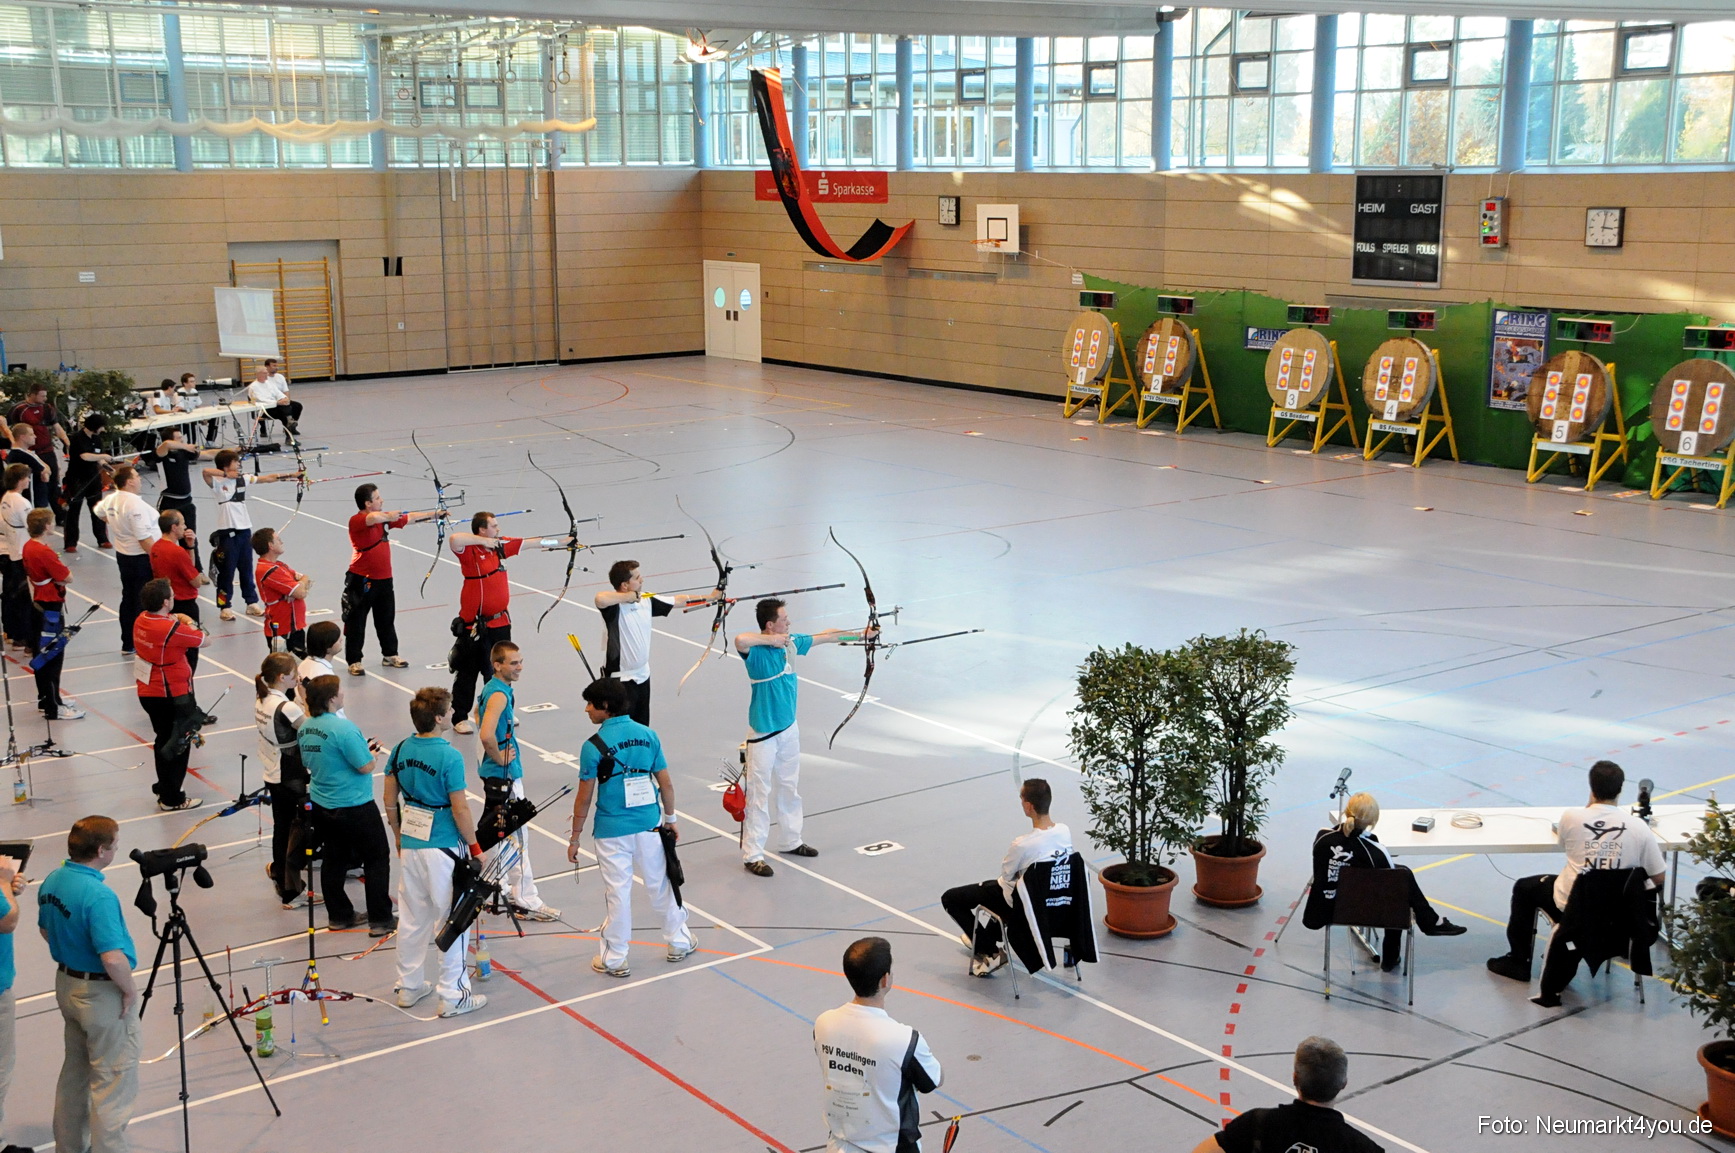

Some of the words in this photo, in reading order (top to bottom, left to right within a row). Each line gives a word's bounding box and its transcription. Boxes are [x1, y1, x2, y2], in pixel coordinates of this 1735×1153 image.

[833, 183, 875, 198] Sparkasse
[1358, 203, 1385, 213] HEIM
[1410, 203, 1438, 214] GAST
[1356, 242, 1376, 253] FOULS
[1382, 243, 1409, 254] SPIELER
[1416, 244, 1436, 255] FOULS
[1509, 311, 1547, 328] RING
[1153, 378, 1160, 391] 2
[1288, 393, 1296, 406] 3
[1386, 404, 1394, 417] 4
[1555, 425, 1564, 439] 5
[1682, 436, 1692, 451] 6
[1662, 456, 1677, 464] FSG
[1680, 458, 1720, 469] Tacherting
[617, 738, 651, 750] Welzheim
[863, 842, 894, 852] 8
[1584, 841, 1623, 850] BOGEN
[1051, 864, 1071, 872] BOGEN
[1584, 857, 1621, 870] NEU
[1050, 874, 1071, 885] NEU
[821, 1044, 834, 1055] PSV
[836, 1047, 877, 1067] Reutlingen
[828, 1060, 864, 1077] Boden
